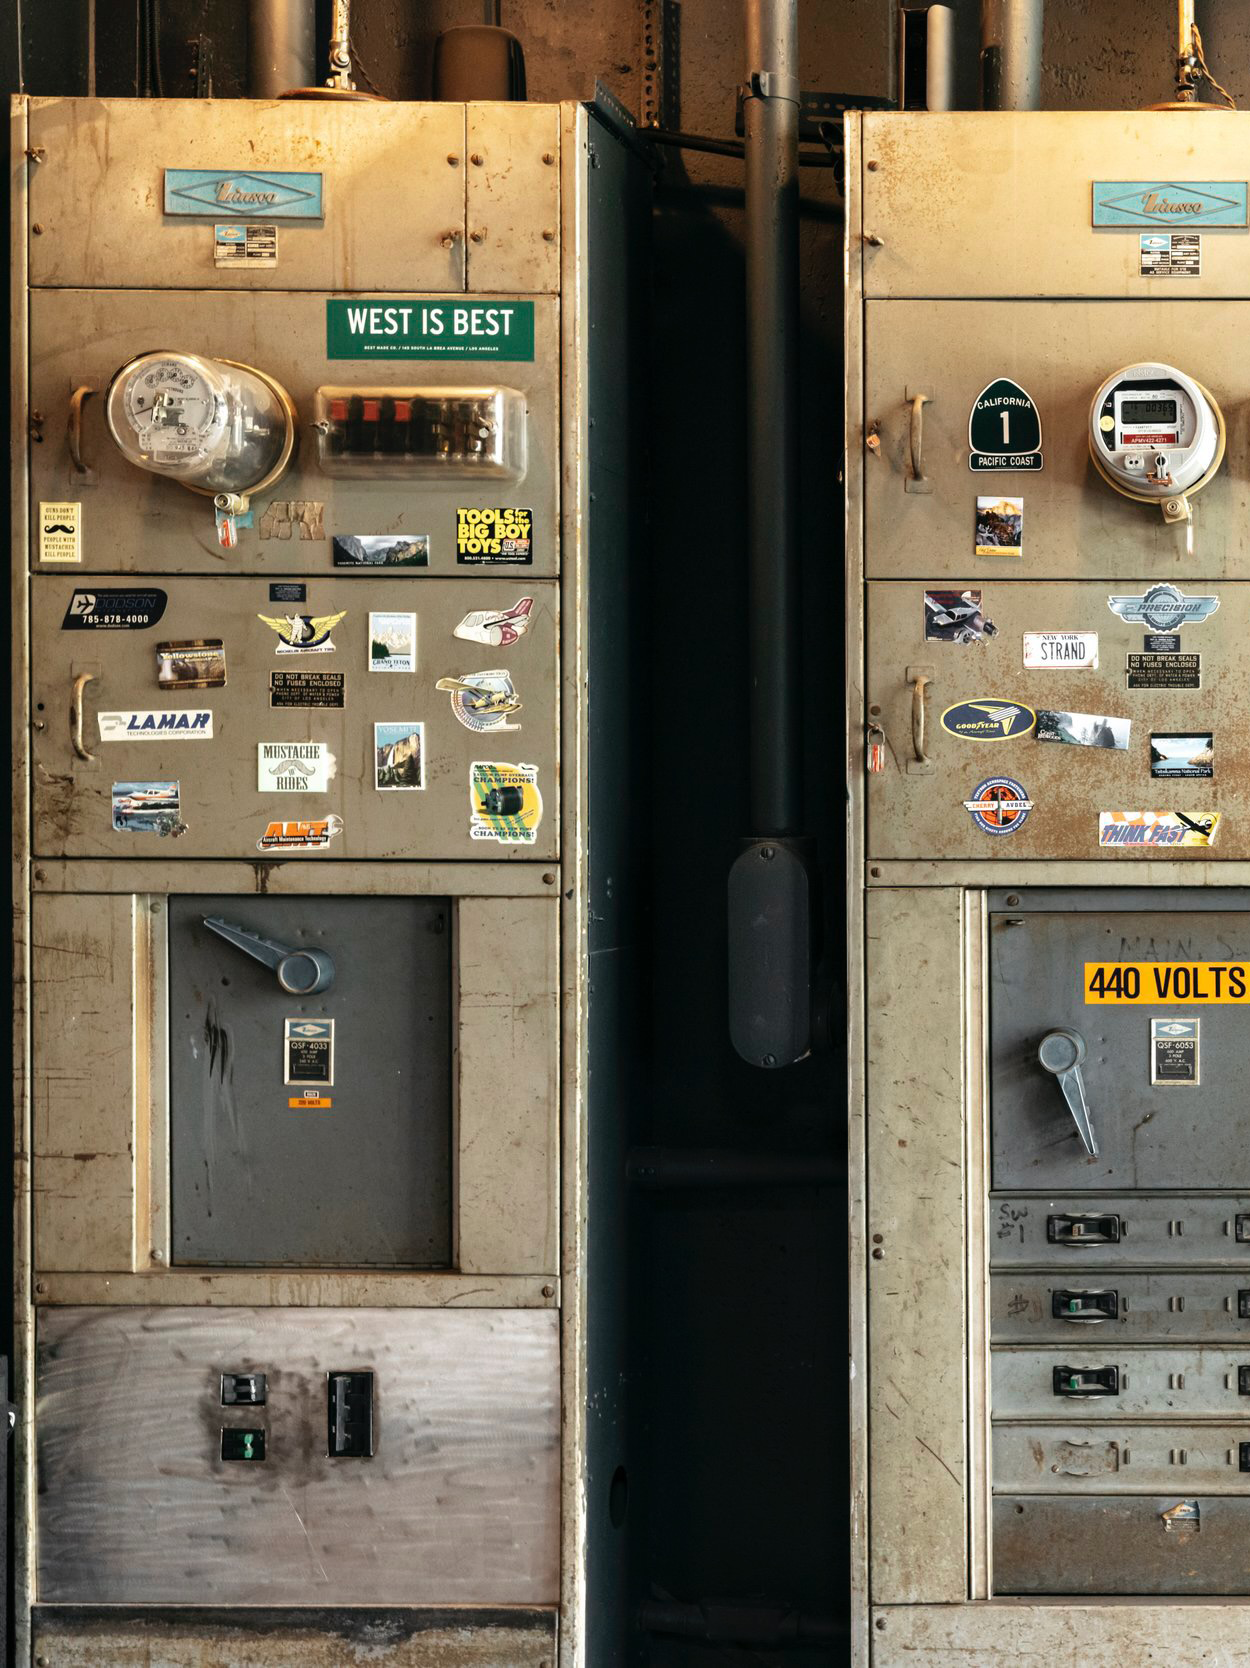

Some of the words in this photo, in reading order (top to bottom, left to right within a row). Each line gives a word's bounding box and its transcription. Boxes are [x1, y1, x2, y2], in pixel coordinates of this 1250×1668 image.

[347, 308, 412, 335] WEST
[422, 308, 444, 336] IS
[453, 309, 514, 336] BEST
[977, 397, 1031, 410] CALIFORNIA
[1000, 411, 1010, 444] 1
[978, 457, 1006, 466] PACIFIC
[1010, 457, 1034, 466] COAST
[458, 509, 514, 524] TOOLS
[458, 524, 489, 538] BIG
[494, 524, 530, 538] BOY
[458, 538, 501, 553] TOYS
[96, 598, 156, 608] DODSON
[1137, 604, 1202, 612] PRECISION
[82, 615, 149, 623] 785-878-4000
[160, 652, 219, 660] Yellowstone
[1041, 642, 1086, 660] STRAND
[127, 714, 210, 730] LAMAR
[956, 722, 1000, 730] GOODYEAR
[264, 745, 320, 759] MUSTACHE
[276, 776, 308, 790] RIDES
[1100, 825, 1148, 842] THINK
[1149, 825, 1188, 843] FAST
[1089, 967, 1140, 998] 440
[1154, 966, 1246, 998] VOLTS
